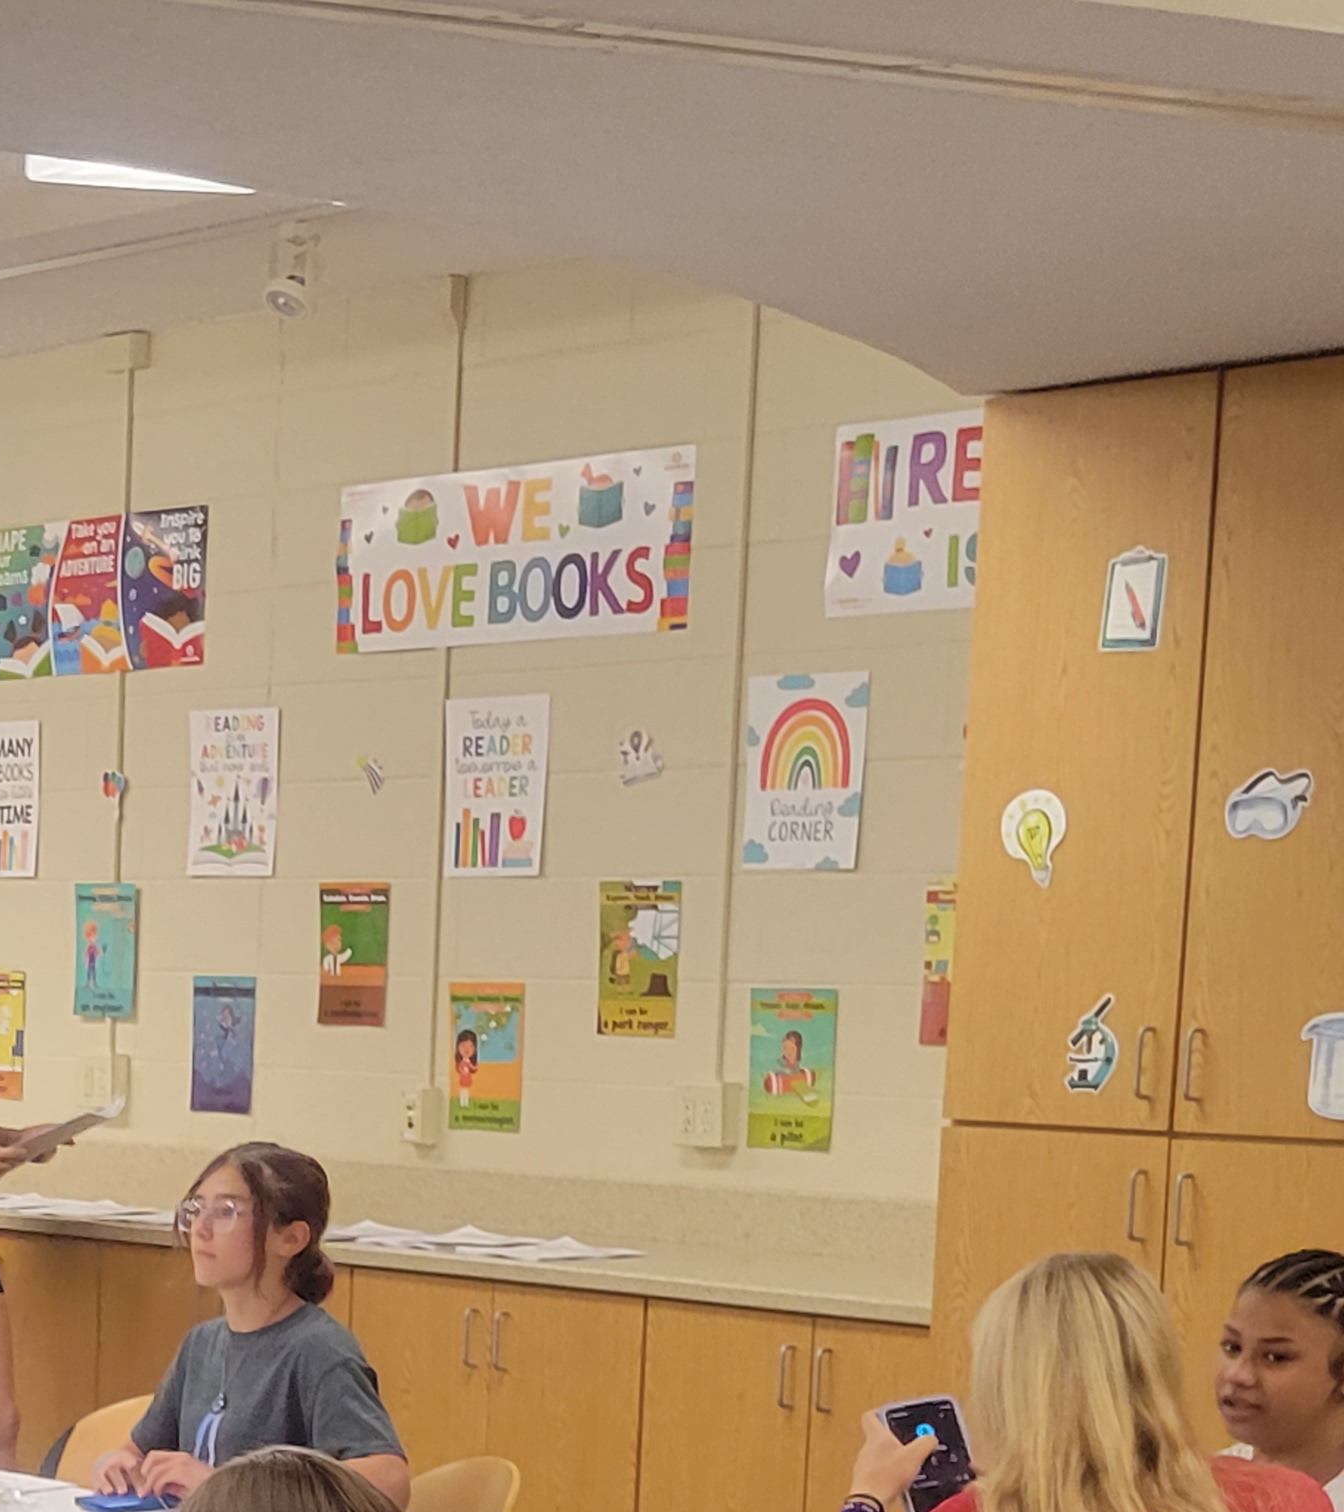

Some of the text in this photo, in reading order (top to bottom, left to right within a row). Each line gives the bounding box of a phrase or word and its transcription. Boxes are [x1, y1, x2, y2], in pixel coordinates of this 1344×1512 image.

[160, 508, 205, 530] Inspire
[463, 478, 553, 546] WE
[71, 521, 117, 541] Take you
[163, 530, 186, 548] you
[82, 539, 115, 555] on an
[59, 554, 115, 578] ADVENTURE
[173, 562, 201, 590] BIG
[361, 546, 654, 634] LOVE BOOKS
[205, 713, 265, 733] READING
[468, 710, 528, 732] Today a
[201, 743, 269, 760] ADVENTURE
[462, 733, 533, 758] READER
[455, 757, 523, 775] tomorrow
[463, 775, 529, 799] LEADER
[0, 804, 33, 824] TIME
[770, 797, 834, 822] Reading
[768, 820, 834, 842] CORNER
[612, 1018, 633, 1033] park
